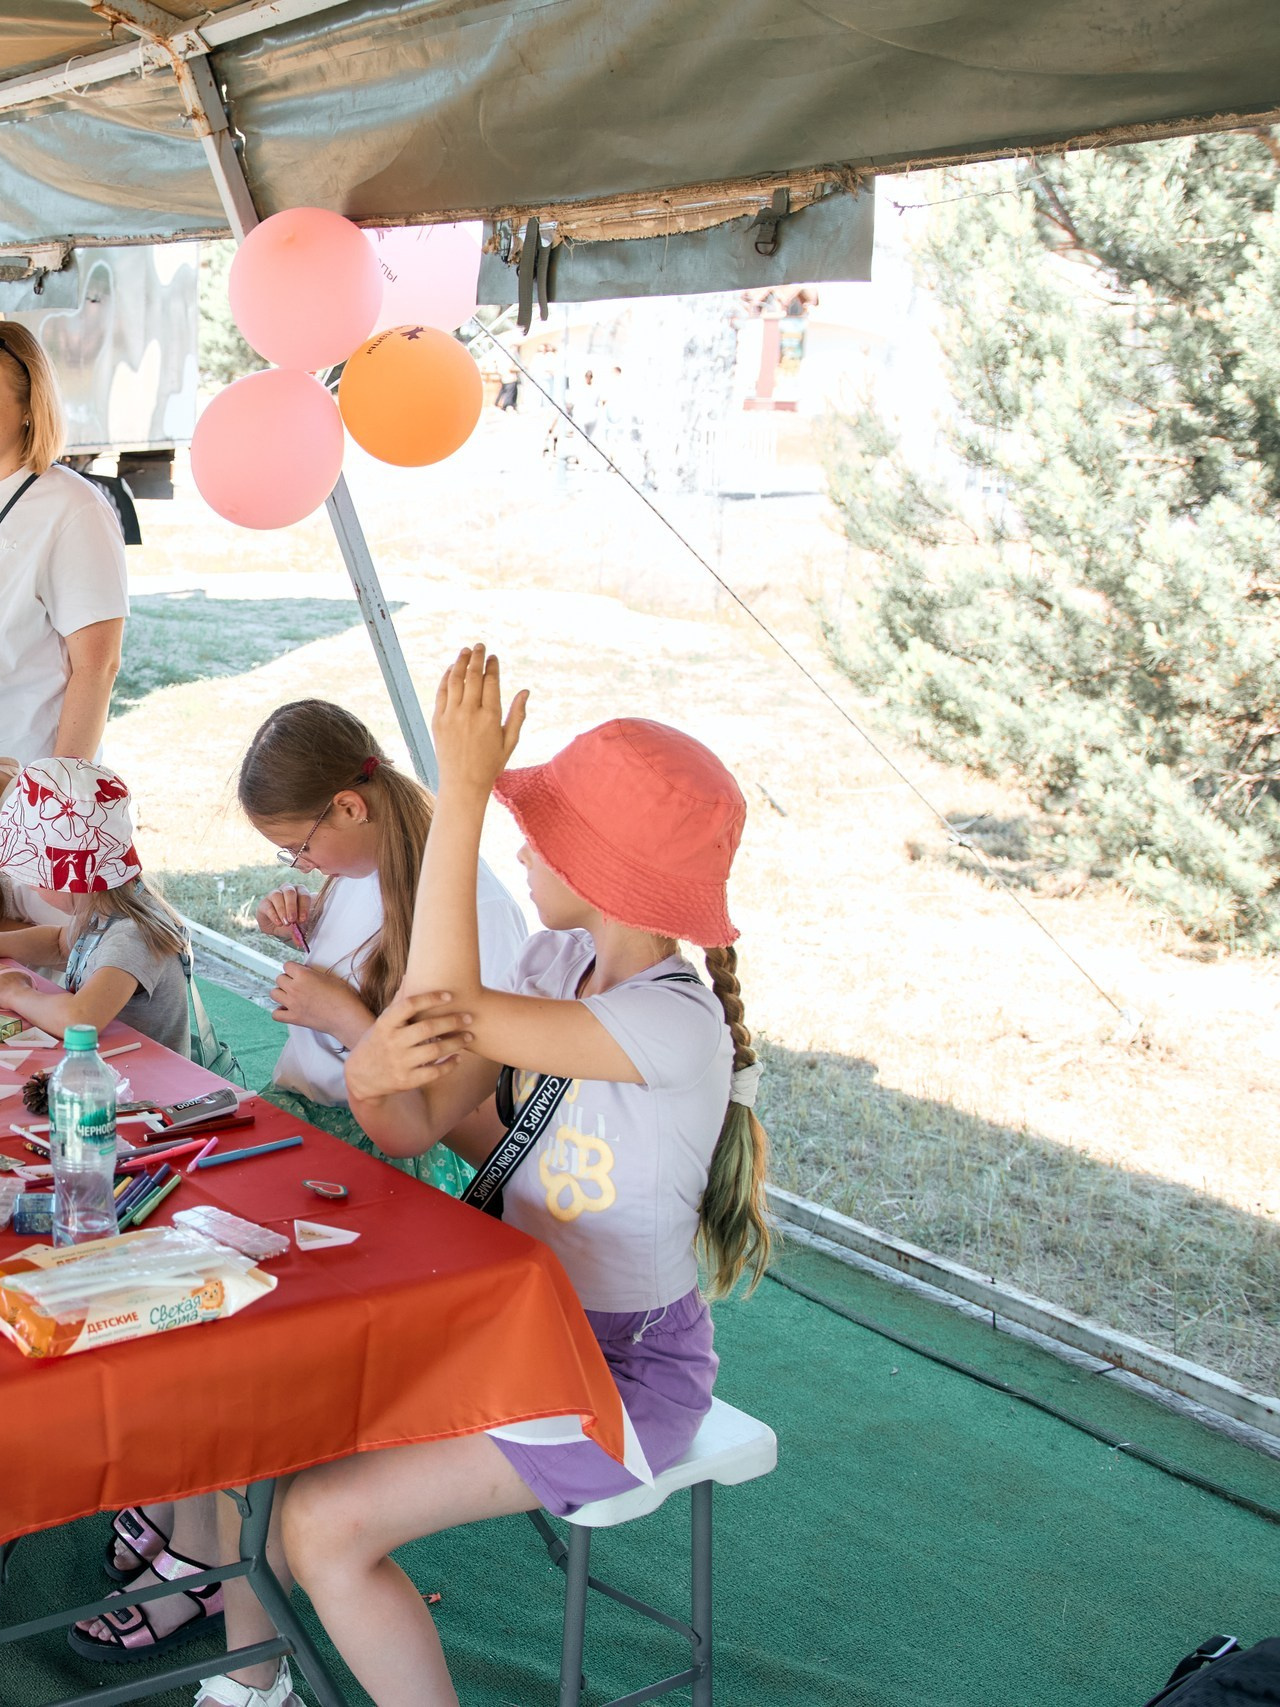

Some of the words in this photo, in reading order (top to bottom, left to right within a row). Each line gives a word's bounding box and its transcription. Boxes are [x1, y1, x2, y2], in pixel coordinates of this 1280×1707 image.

[378, 257, 398, 283] пы
[523, 1077, 560, 1131] CHAMPS
[495, 1142, 520, 1169] BORN
[473, 1167, 503, 1201] CHAMPS
[87, 1312, 139, 1334] ДЕТСКИЕ
